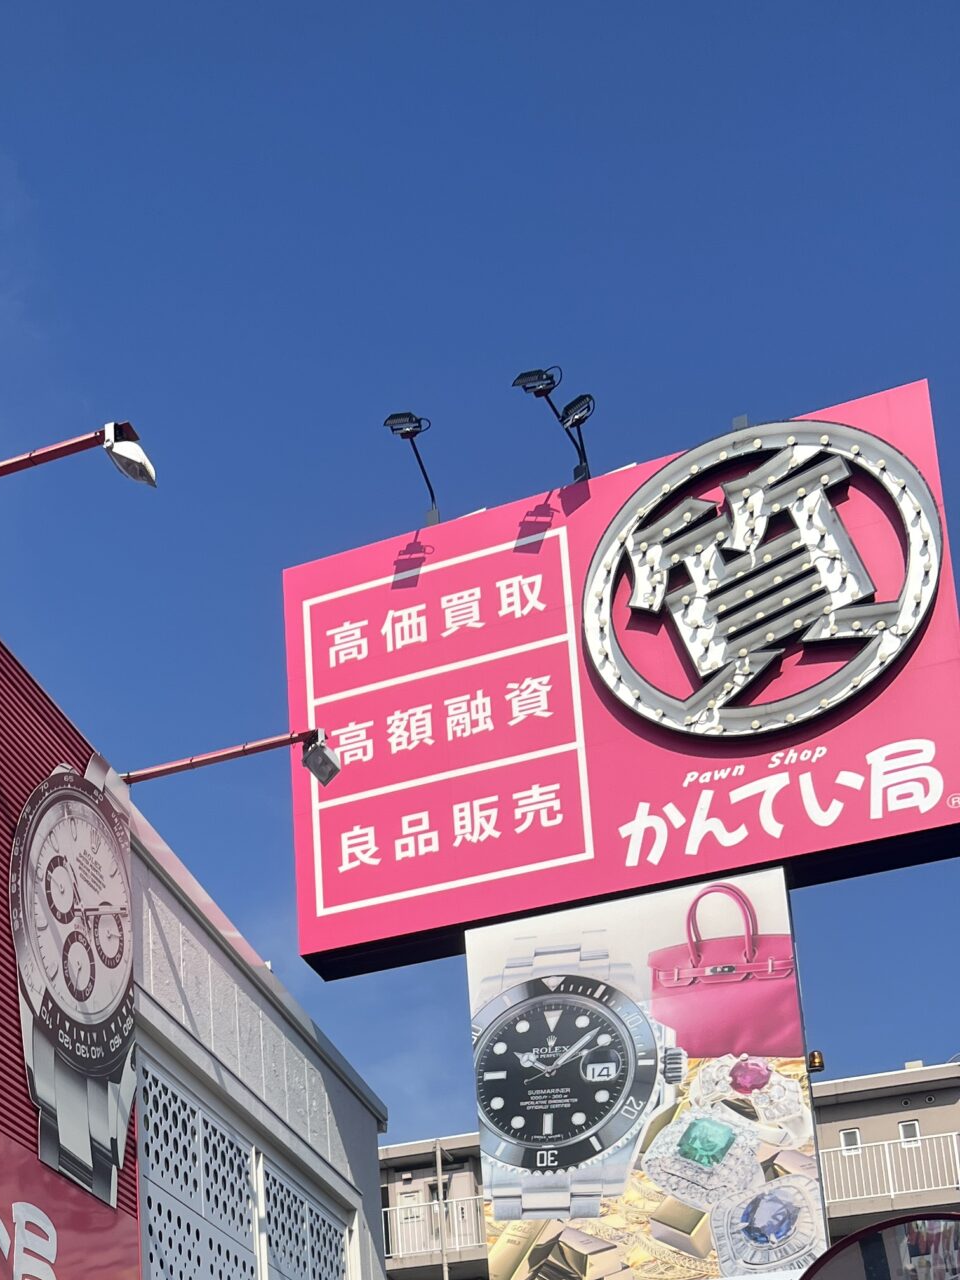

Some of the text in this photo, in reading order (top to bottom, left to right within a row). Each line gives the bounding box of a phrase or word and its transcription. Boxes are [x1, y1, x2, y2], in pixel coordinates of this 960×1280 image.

[325, 573, 547, 669] 高価買取
[331, 673, 553, 767] 高額融資
[618, 738, 945, 867] かんてい局
[682, 744, 827, 788] Pawn Shop
[336, 782, 564, 873] 良品販売
[532, 1045, 570, 1055] ROLEX
[591, 1067, 612, 1079] 14
